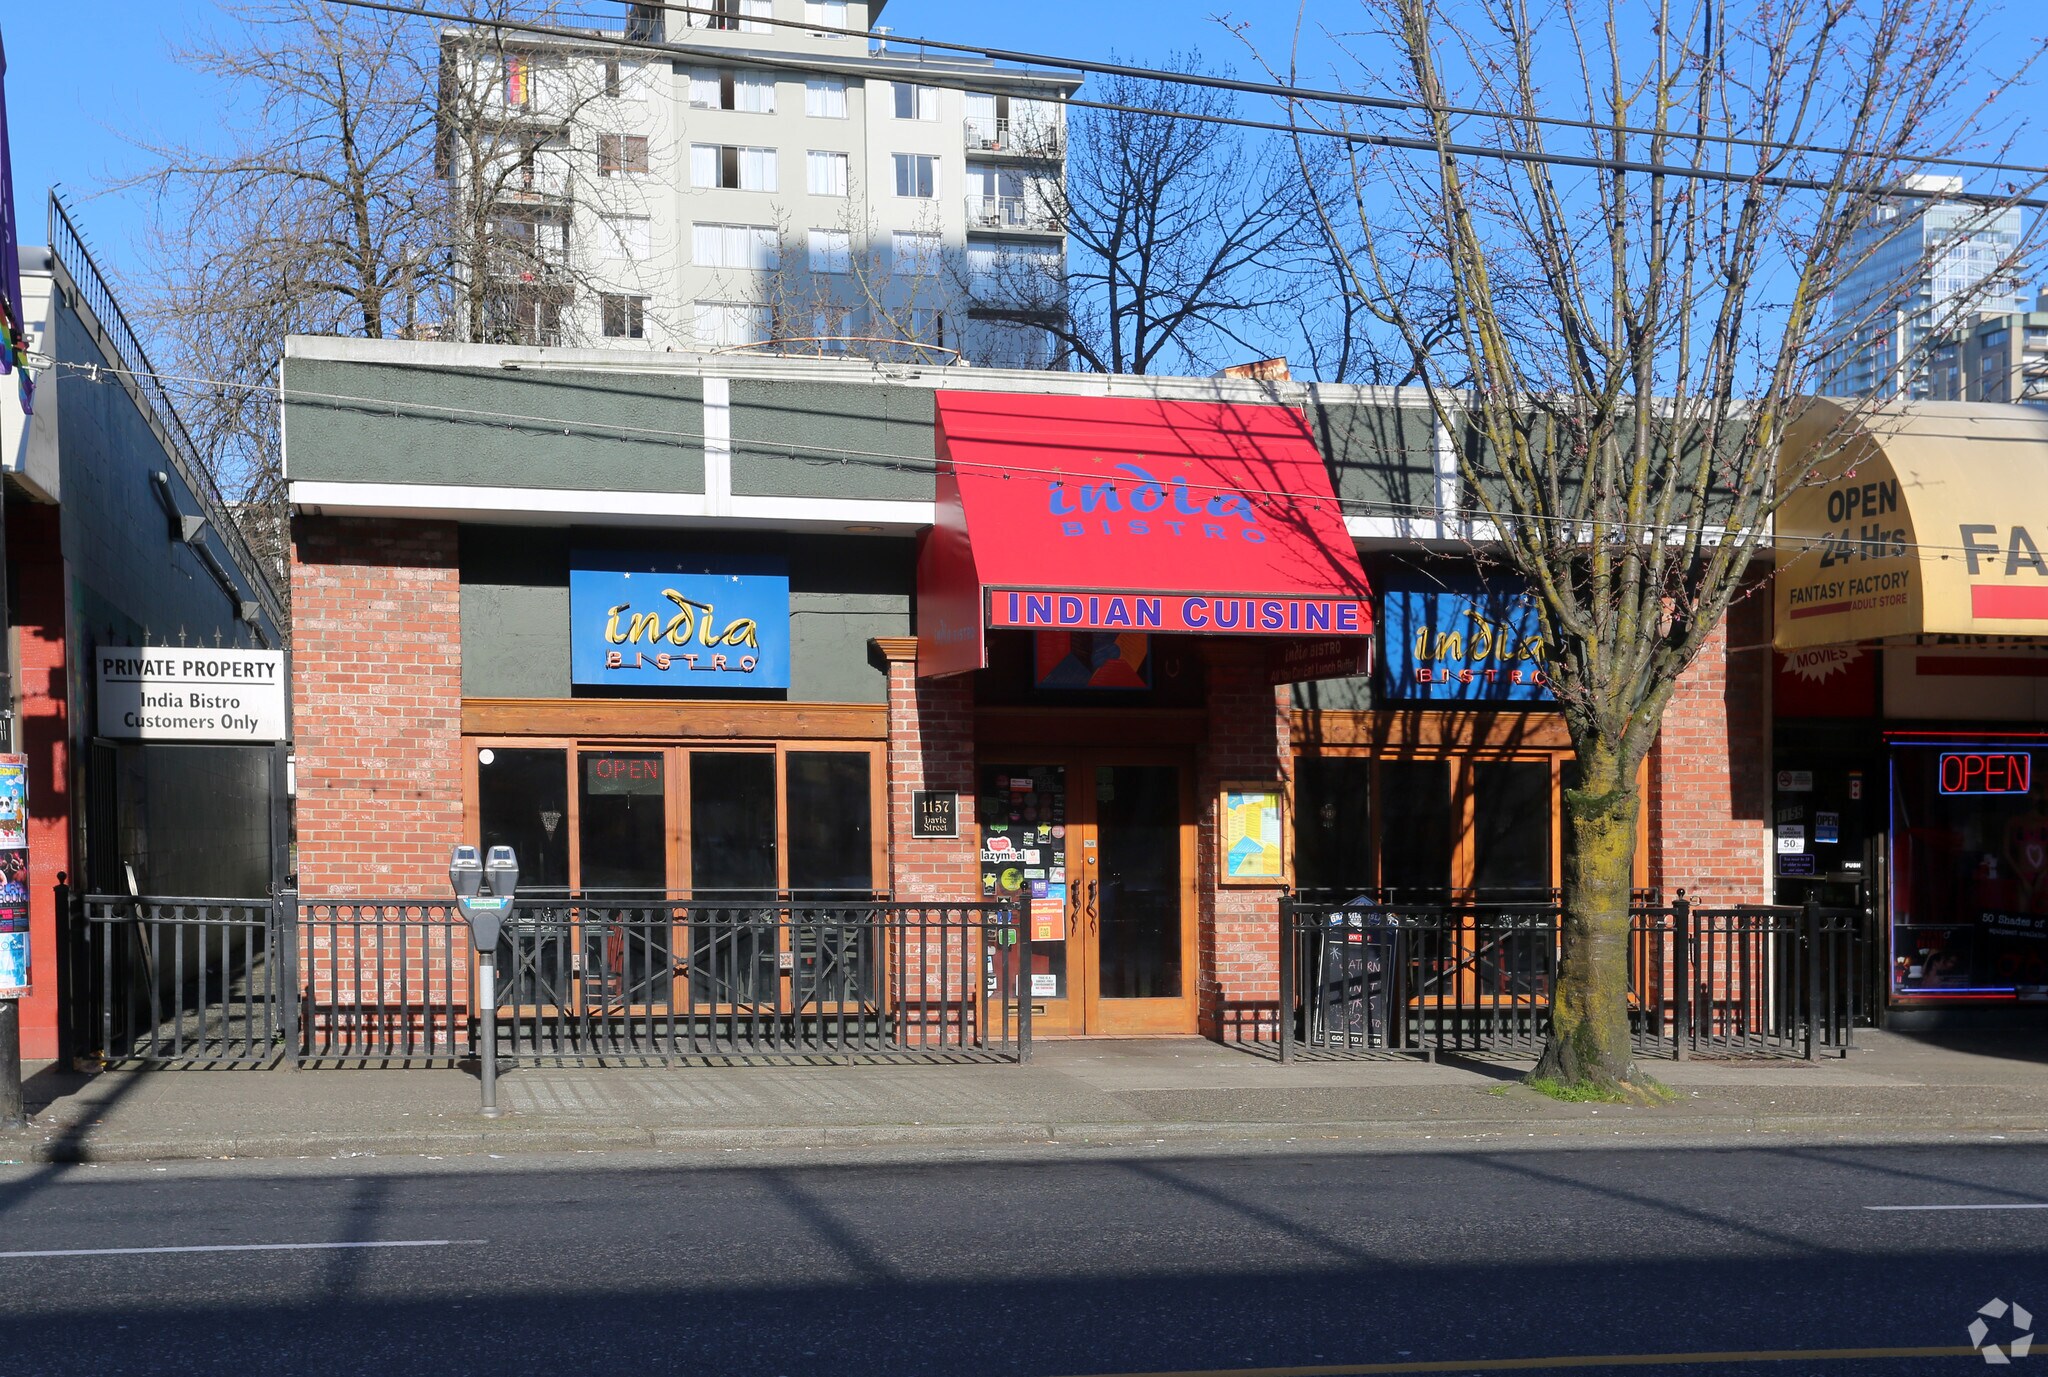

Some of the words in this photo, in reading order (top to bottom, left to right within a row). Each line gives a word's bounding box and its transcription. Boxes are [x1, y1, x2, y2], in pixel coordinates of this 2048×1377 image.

[1047, 463, 1256, 522] india
[1827, 479, 1897, 523] OPEN
[1062, 520, 1267, 544] BISTRO
[1820, 528, 1850, 568] 24
[1861, 523, 1907, 560] Hrs
[1959, 524, 2048, 575] FA
[1790, 582, 1844, 605] FANTASY
[1849, 570, 1909, 596] FACTORY
[1008, 592, 1162, 627] INDIAN
[1182, 597, 1359, 631] CUISINE
[1851, 597, 1876, 610] ADULT
[1880, 593, 1907, 607] STORE
[605, 588, 758, 647] india
[1414, 609, 1545, 662] india
[606, 651, 757, 671] BISTRO
[1797, 648, 1848, 668] MOVIES
[103, 659, 175, 677] PRIVATE
[183, 661, 276, 679] PROPERTY
[140, 692, 183, 709] India
[189, 693, 240, 710] Bistro
[123, 712, 215, 730] Customers
[220, 712, 259, 734] Only
[596, 759, 658, 779] OPEN
[1942, 755, 2029, 792] OPEN
[922, 800, 950, 813] 1157
[924, 823, 948, 832] Street
[925, 815, 947, 824] Davie
[1817, 814, 1837, 826] OPEN
[981, 849, 1025, 862] lazymeal
[1982, 913, 1994, 923] 50
[1998, 913, 2031, 926] Shades
[2034, 919, 2046, 928] of
